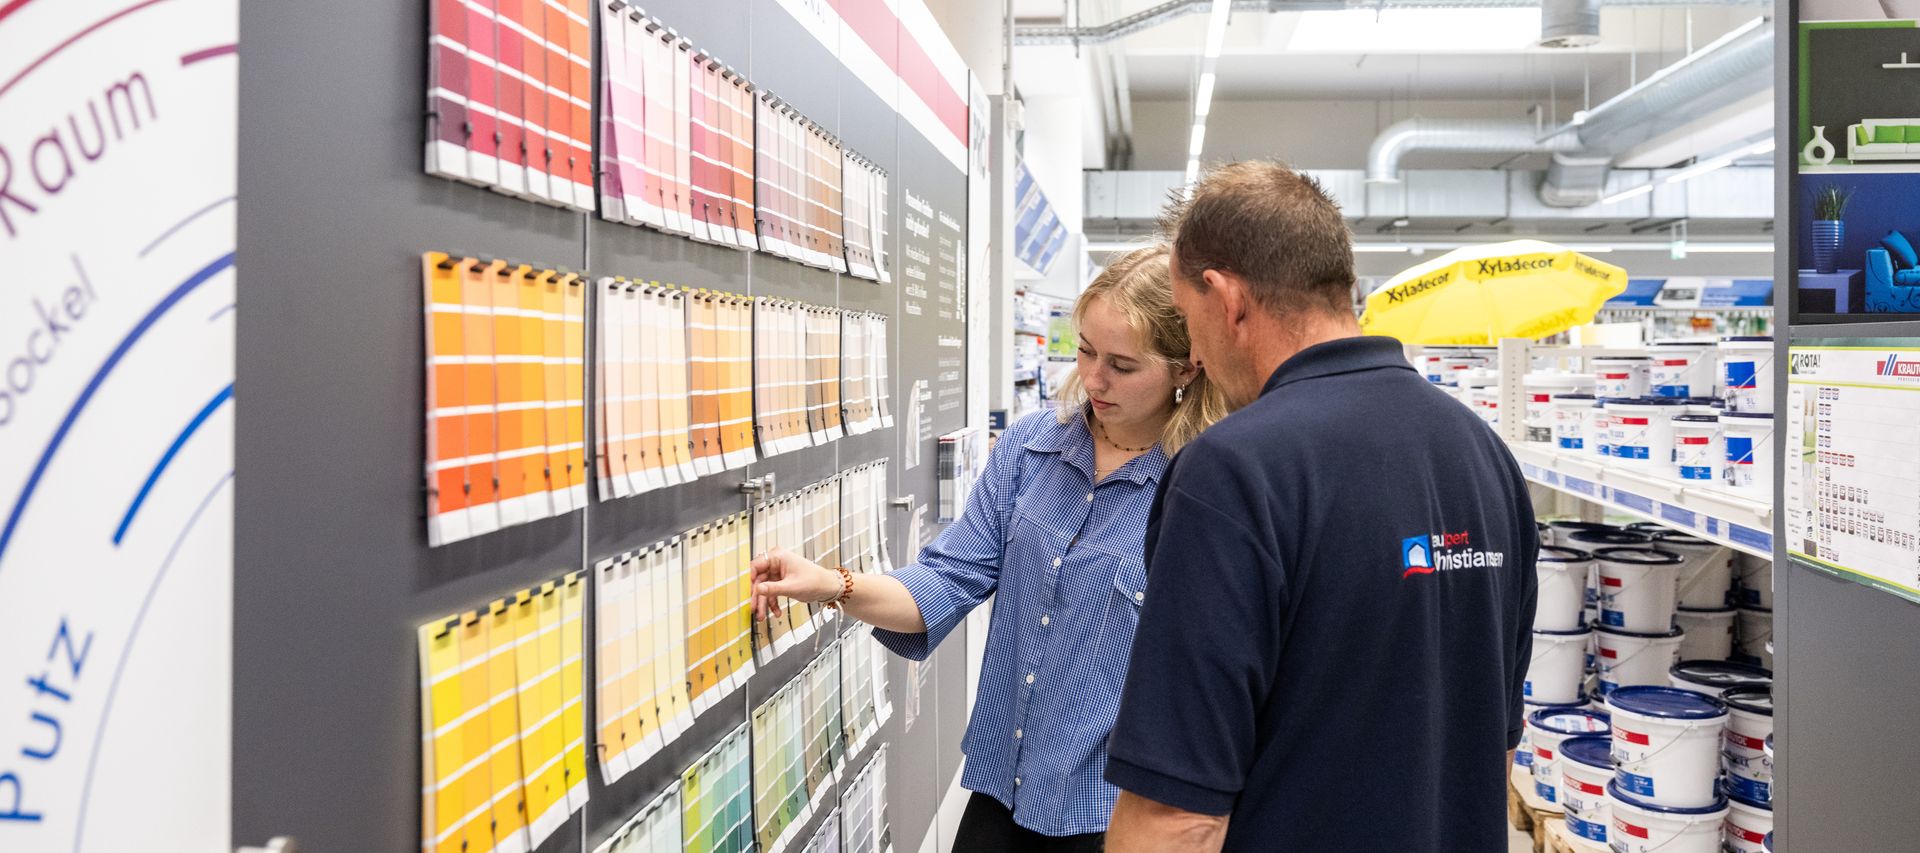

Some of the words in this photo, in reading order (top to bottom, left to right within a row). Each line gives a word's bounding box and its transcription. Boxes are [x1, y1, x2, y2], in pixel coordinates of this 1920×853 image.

[1478, 256, 1555, 277] Xyladecor
[1386, 271, 1450, 304] Xyladecor
[0, 614, 94, 822] Putz
